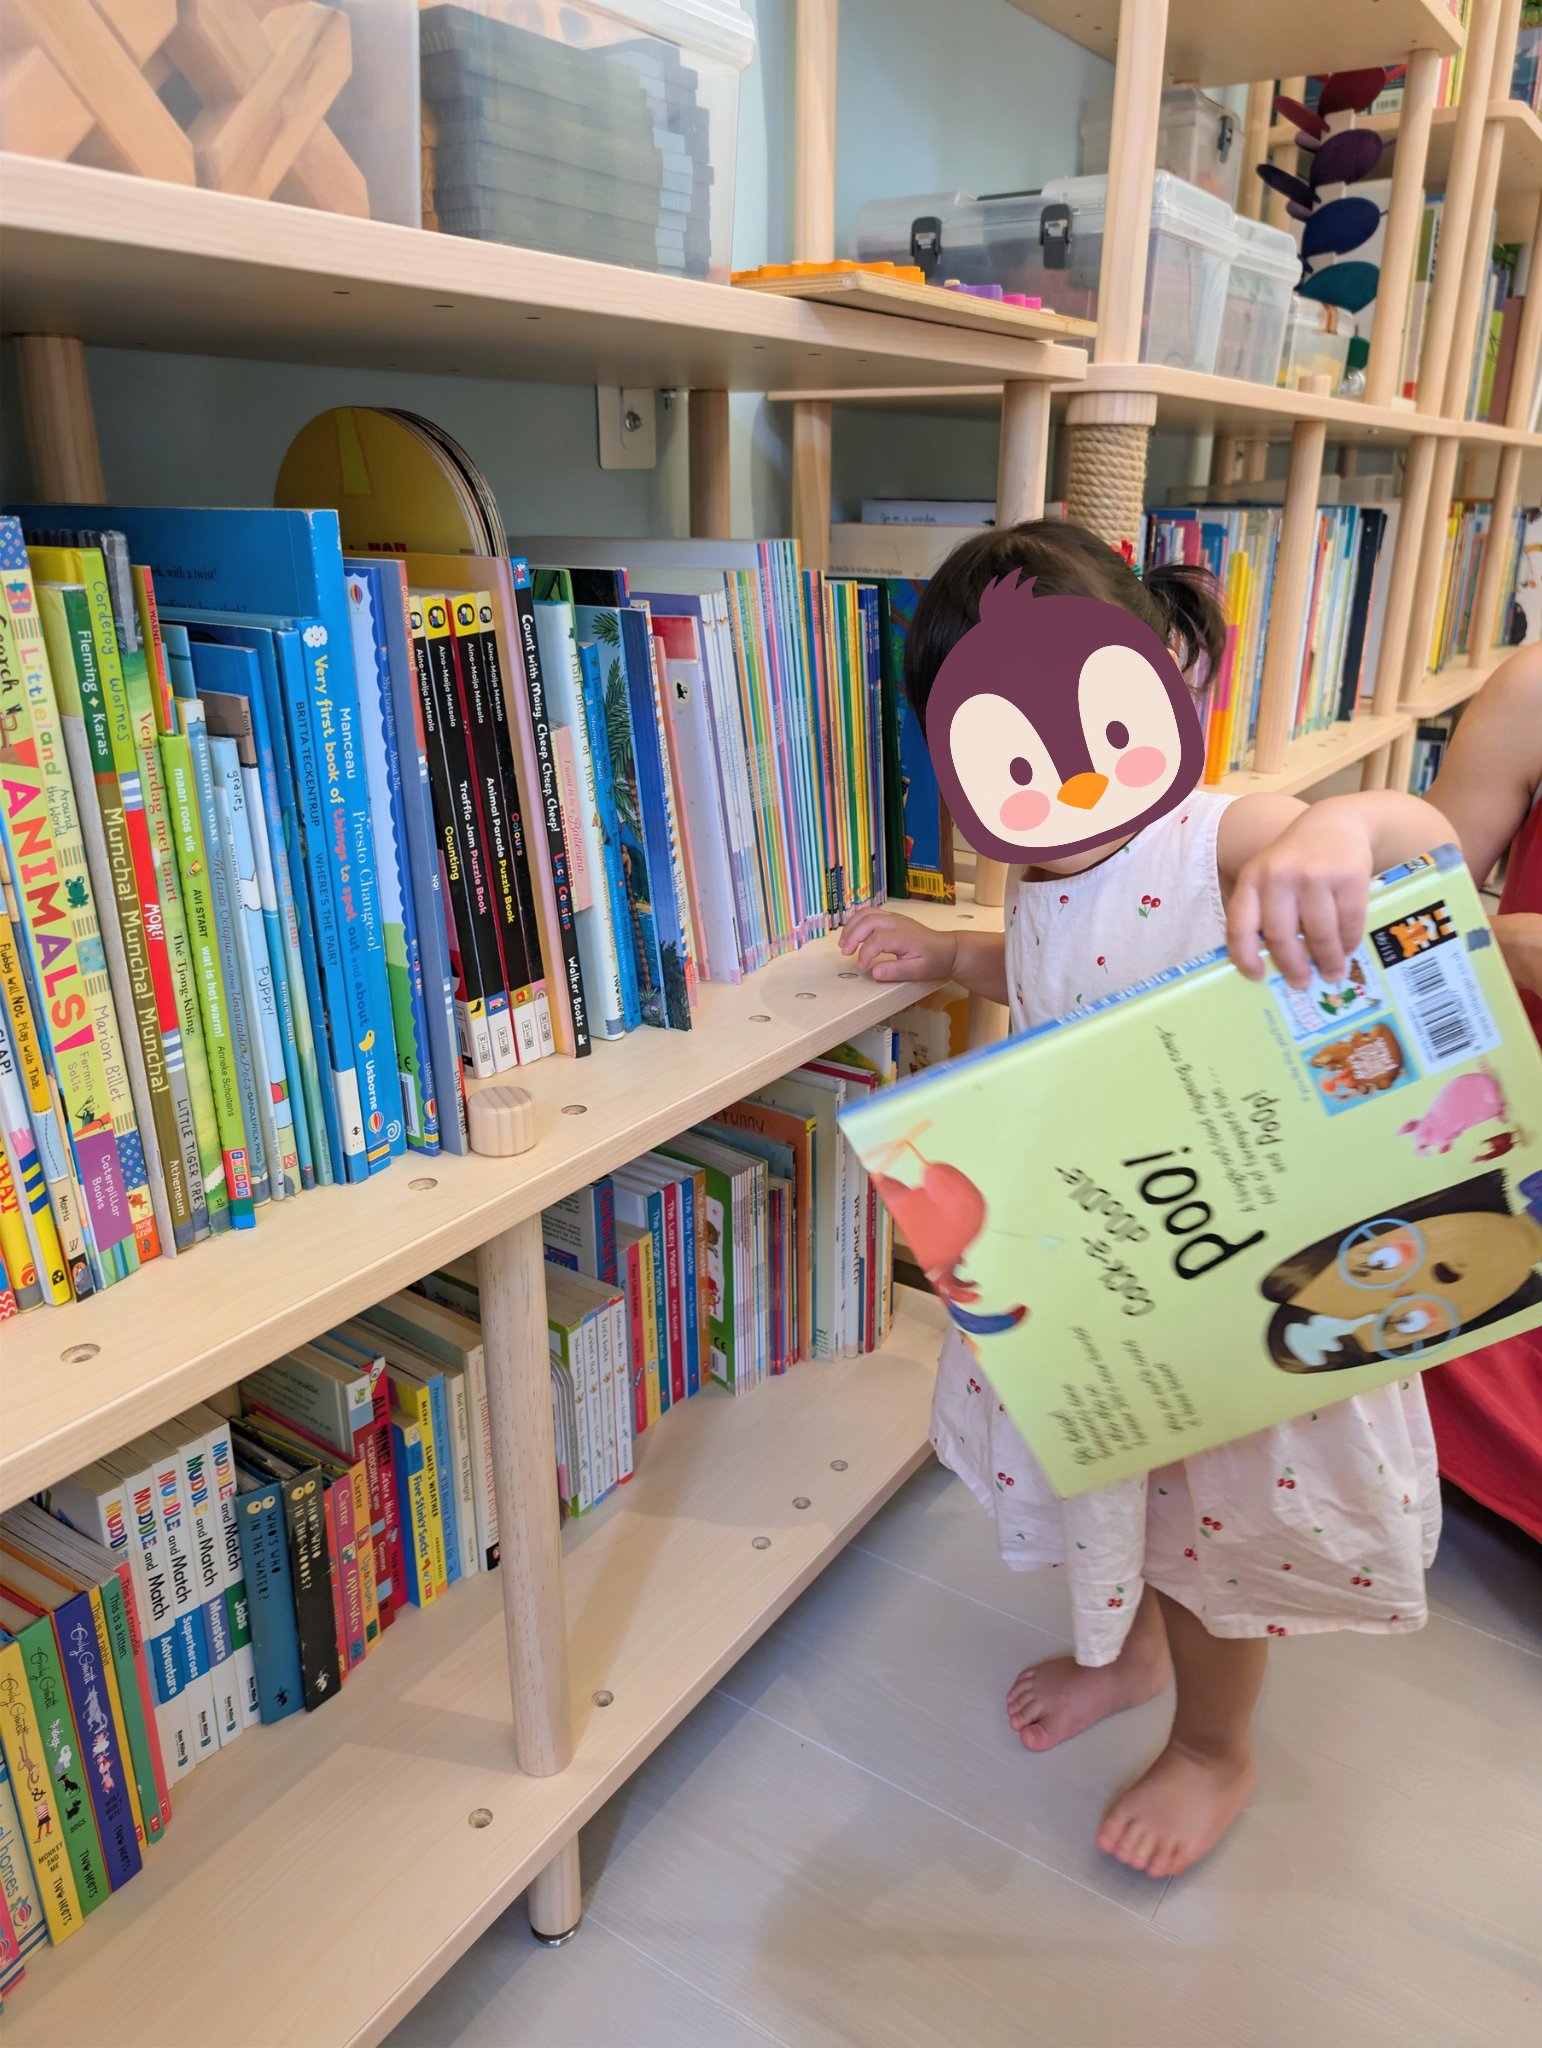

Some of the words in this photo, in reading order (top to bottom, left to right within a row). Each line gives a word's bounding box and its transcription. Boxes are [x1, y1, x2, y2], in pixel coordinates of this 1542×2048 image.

[149, 610, 162, 647] WARNES
[522, 614, 535, 652] Count
[92, 581, 114, 655] Corderoy
[109, 678, 130, 741] Warnes
[314, 654, 329, 694] Very
[527, 654, 537, 680] with
[77, 630, 98, 693] Fleming
[92, 713, 109, 755] Karas
[416, 649, 430, 697] Aino-Maija
[424, 697, 434, 732] Metsola
[438, 645, 451, 693] Aino-Maija
[446, 693, 456, 728] Metsola
[467, 643, 479, 690] Aino-Maija
[474, 690, 484, 724] Metsola
[487, 642, 498, 688] Aino-Maija
[494, 688, 503, 722] Metsola
[316, 698, 335, 737] first
[339, 708, 356, 779] Manceau
[537, 723, 548, 760] Cheep,
[139, 712, 165, 815] Verjaardag
[296, 703, 308, 745] BRITTA
[302, 746, 320, 827] TECKENTRUP
[324, 742, 341, 785] book
[46, 786, 56, 804] the
[173, 768, 187, 802] maan
[197, 735, 214, 803] CHARLOTTE
[207, 807, 219, 843] VOAKE
[227, 770, 243, 812] graves
[330, 787, 345, 805] of
[459, 780, 473, 820] Traffic
[486, 777, 498, 815] Animal
[48, 806, 65, 838] World
[59, 788, 78, 832] Around
[180, 804, 192, 833] roos
[546, 797, 561, 833] Cheep!
[155, 820, 171, 855] met
[184, 836, 195, 853] vis
[333, 808, 346, 862] things
[352, 811, 371, 864] Presto
[466, 821, 476, 849] Jam
[492, 816, 504, 858] Parade
[511, 812, 524, 857] Colours
[568, 815, 584, 874] Ballerina
[445, 826, 459, 881] Counting
[470, 849, 482, 885] Puzzle
[553, 852, 566, 884] Lucy
[161, 860, 178, 904] taart
[315, 853, 328, 904] WHERE'S
[339, 865, 350, 883] to
[431, 874, 439, 891] NO!
[499, 859, 511, 894] Puzzle
[193, 889, 202, 905] AVI
[341, 885, 357, 922] spot
[358, 867, 381, 952] Change-o!
[475, 886, 486, 915] Book
[504, 895, 514, 924] Book
[558, 885, 572, 929] Cousins
[2, 779, 95, 1053] ANIMALS!
[144, 903, 165, 941] MORE!
[197, 907, 208, 938] START
[321, 908, 333, 930] THE
[0, 942, 14, 974] Flubby
[104, 808, 133, 902] Muncha!
[121, 909, 153, 1000] Muncha!
[139, 1009, 170, 1094] Muncha!
[173, 931, 183, 958] Thé
[201, 946, 211, 968] wat
[324, 935, 338, 967] PAIR?
[8, 977, 20, 995] Will
[205, 970, 213, 980] is
[207, 981, 217, 999] het
[256, 965, 274, 1017] PUPPY!
[347, 925, 359, 954] out
[355, 981, 369, 1028] about
[567, 956, 581, 994] Walker
[13, 995, 26, 1018] Not
[177, 960, 195, 1035] Tjong-Khing
[572, 994, 583, 1027] Books
[210, 1002, 225, 1038] warm!
[23, 1044, 34, 1064] with
[94, 1006, 113, 1062] Marion
[105, 1066, 125, 1102] Billet
[218, 1046, 229, 1076] Anneke
[28, 1066, 40, 1090] That
[366, 1060, 378, 1111] Usborne
[222, 1078, 234, 1117] Scholtens
[247, 1092, 260, 1138] CANDLEWICK
[177, 1098, 193, 1139] LITTLE
[185, 1142, 199, 1178] TIGER
[253, 1140, 263, 1163] PRESS
[92, 1177, 104, 1210] Books
[100, 1154, 120, 1218] Caterpillar
[169, 1160, 185, 1216] Atheneum
[59, 1193, 71, 1223] Morris
[371, 1395, 387, 1424] ALL
[376, 1424, 391, 1468] MINE!
[425, 1445, 433, 1477] ELMER'S
[186, 1454, 208, 1516] MUDDLE
[212, 1440, 234, 1500] MUDDLE
[367, 1446, 379, 1495] CROCODILE
[381, 1471, 392, 1499] Zehra
[413, 1475, 422, 1496] Five
[158, 1470, 181, 1531] MUDDLE
[353, 1473, 363, 1510] Carter
[428, 1478, 437, 1518] WEATHER
[134, 1487, 156, 1549] MUDDLE
[197, 1518, 208, 1538] and
[221, 1503, 233, 1523] and
[251, 1519, 261, 1532] IN
[266, 1511, 279, 1546] WHO'S
[295, 1520, 307, 1542] THE
[307, 1496, 319, 1532] WHO'S
[384, 1500, 395, 1525] Hicks
[415, 1497, 427, 1528] Stinky
[144, 1551, 158, 1571] and
[168, 1535, 180, 1556] and
[224, 1523, 241, 1572] Match
[252, 1536, 264, 1556] THE
[270, 1549, 281, 1574] WHO
[311, 1534, 321, 1559] WHO
[338, 1489, 350, 1526] Carter
[346, 1569, 361, 1633] Opposites
[419, 1529, 429, 1558] Socks
[171, 1555, 192, 1605] Match
[198, 1538, 219, 1587] Match
[256, 1560, 270, 1601] WATER?
[299, 1544, 312, 1591] WOODS?
[148, 1573, 170, 1622] Match
[234, 1598, 249, 1630] Jobs
[183, 1616, 199, 1679] Superheroes
[209, 1602, 226, 1662] Monsters
[160, 1636, 178, 1697] Adventure
[69, 1818, 87, 1834] DOGS
[38, 1841, 64, 1865] MONKEY
[84, 1870, 98, 1899] HOOTS
[58, 1897, 73, 1927] HOOTS
